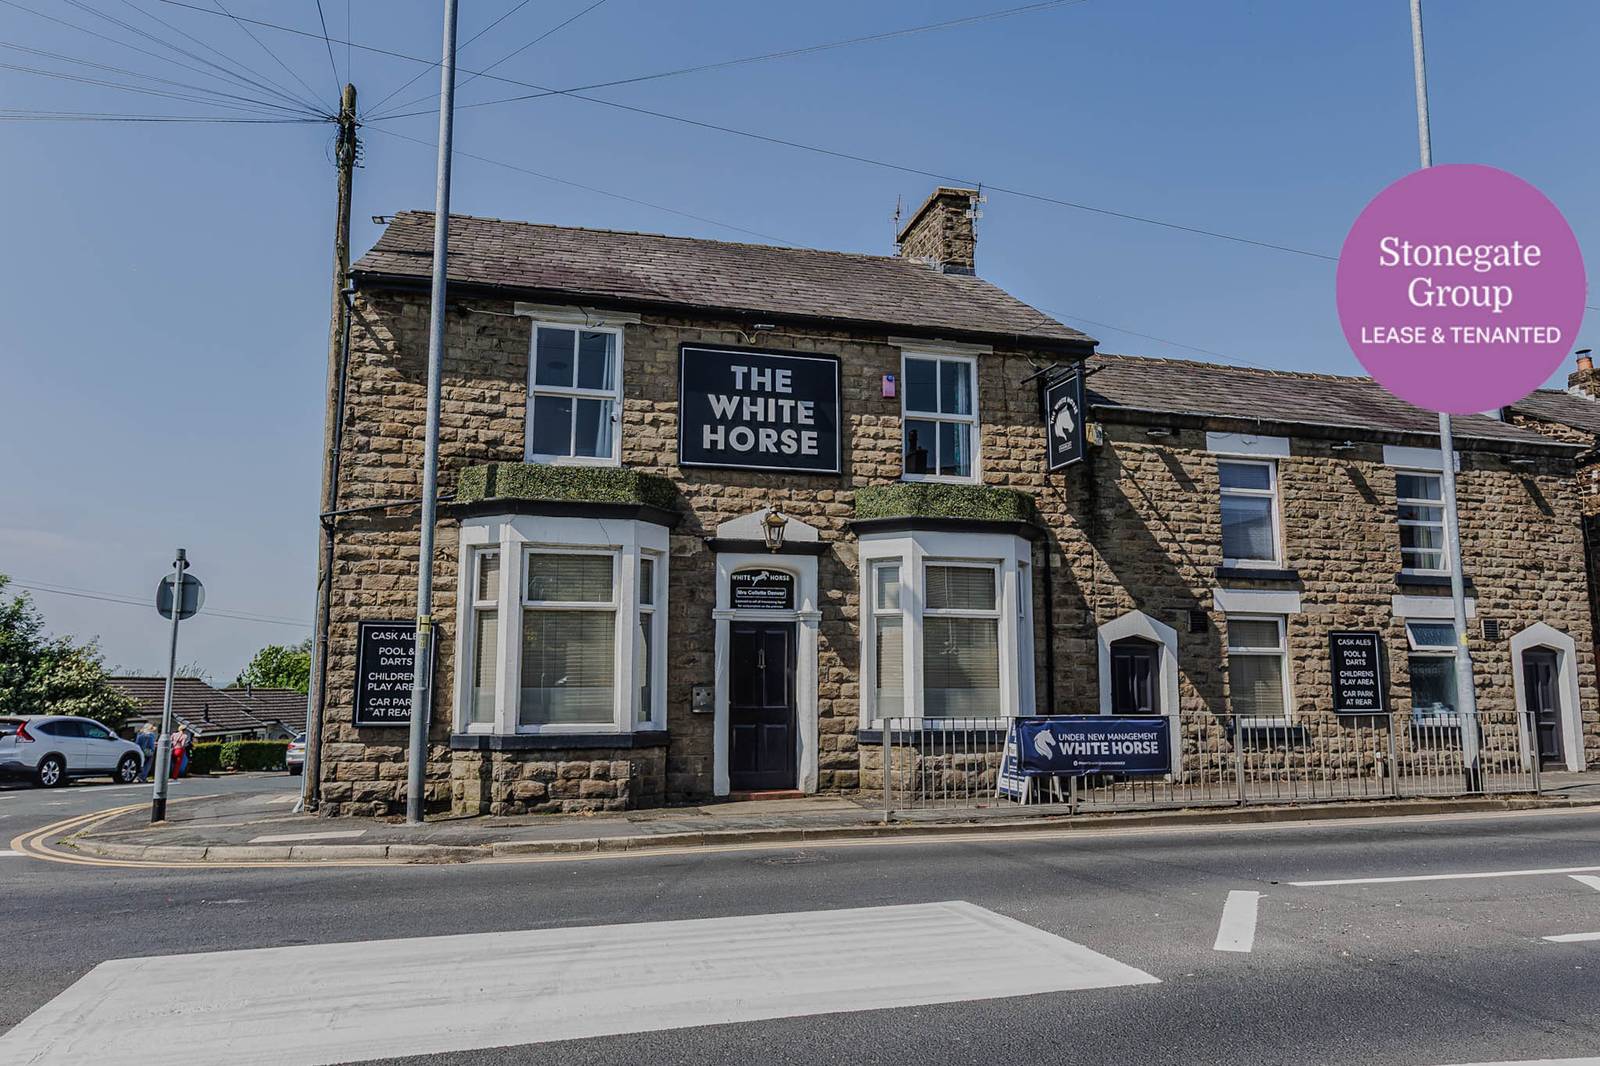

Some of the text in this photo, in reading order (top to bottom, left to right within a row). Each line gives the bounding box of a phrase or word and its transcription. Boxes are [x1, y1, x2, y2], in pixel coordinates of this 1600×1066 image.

[730, 365, 792, 393] THE
[707, 394, 815, 425] WHITE
[703, 424, 818, 455] HORSE
[371, 632, 398, 640] CASK
[378, 647, 415, 655] POOL &
[380, 657, 413, 666] DARTS
[1339, 670, 1374, 678] CHILDRENS
[1340, 678, 1375, 686] PLAY AREA
[367, 683, 415, 691] PLAY ARE
[1342, 690, 1374, 698] CAR PARK
[369, 698, 412, 706] CAR PAR
[1346, 698, 1373, 706] AT REAR
[372, 708, 386, 717] AT
[1058, 732, 1158, 741] UNDER NEW MANAGEMENT
[1059, 741, 1159, 755] WHITE HORSE
